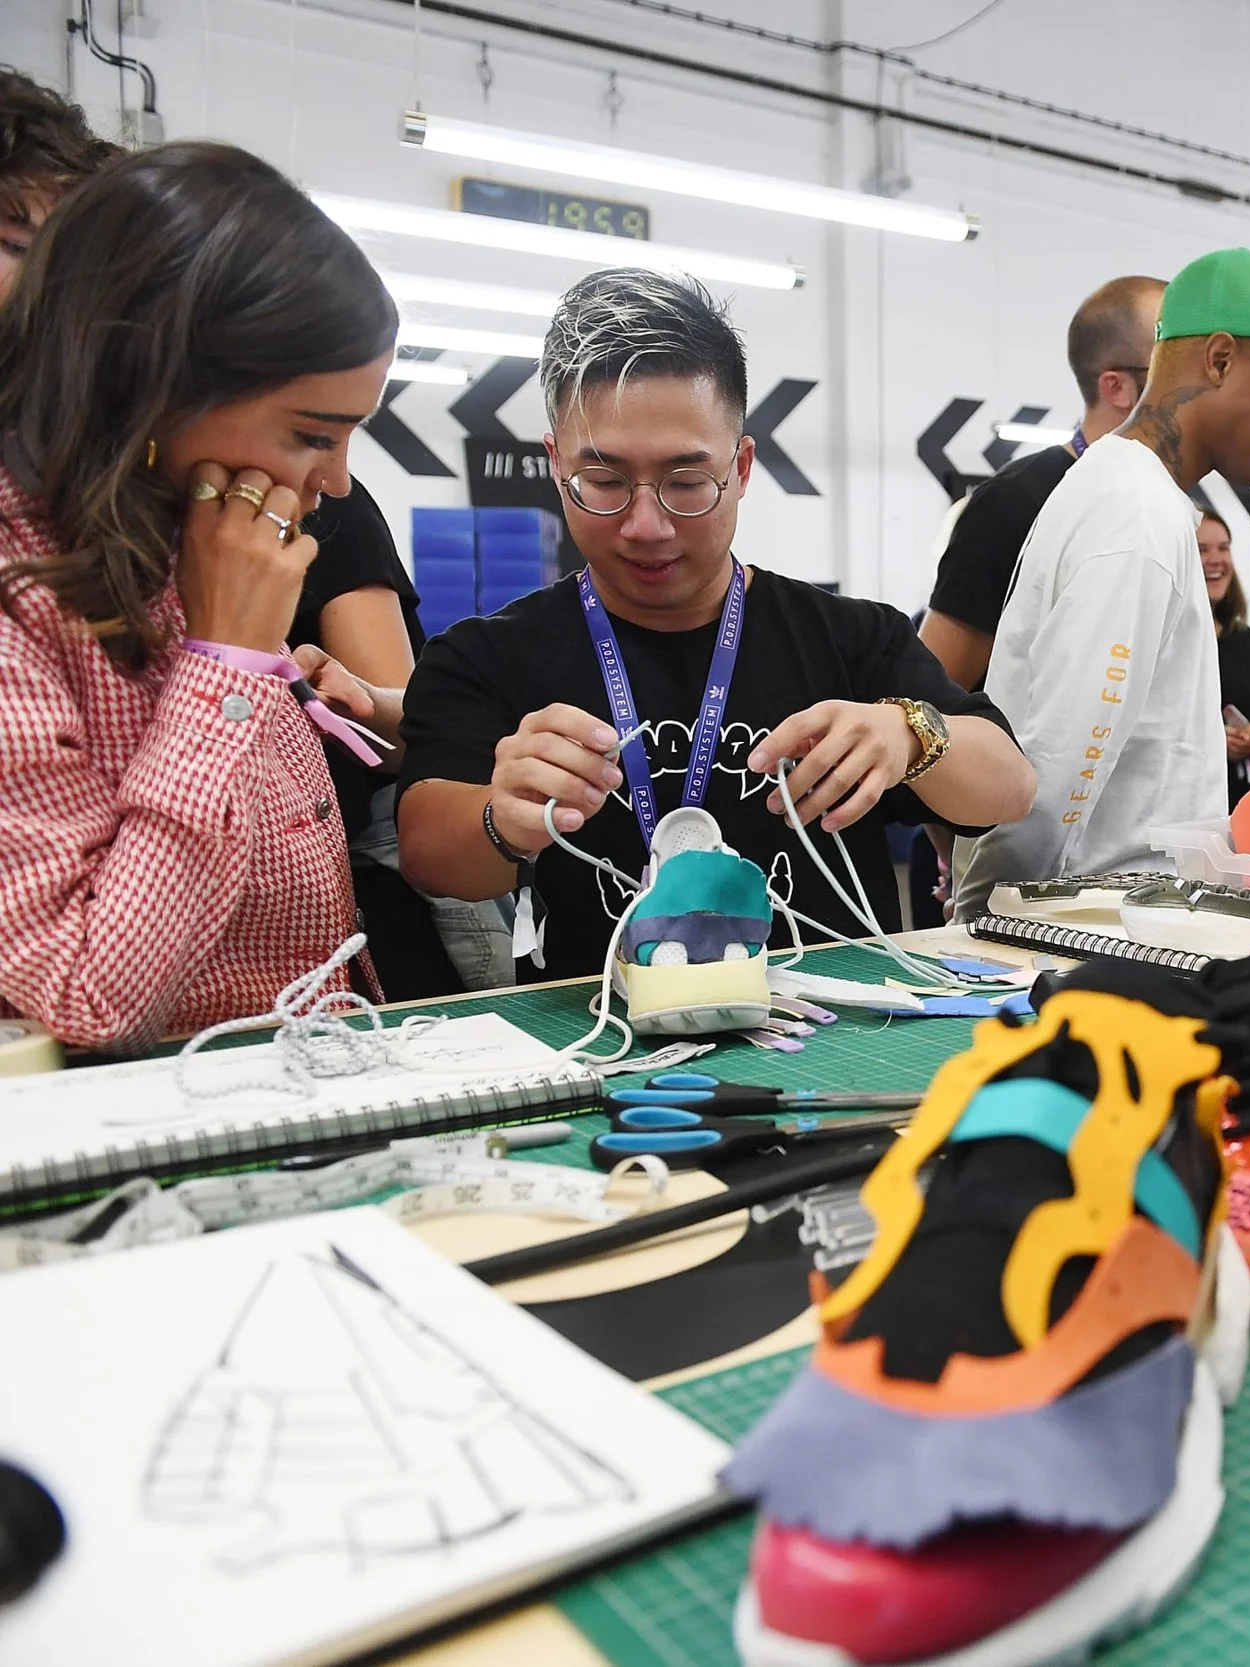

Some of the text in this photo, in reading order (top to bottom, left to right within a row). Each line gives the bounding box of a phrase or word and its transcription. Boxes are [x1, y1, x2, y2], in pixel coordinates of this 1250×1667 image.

[521, 455, 553, 479] ST
[1061, 643, 1131, 825] GEARS FOR
